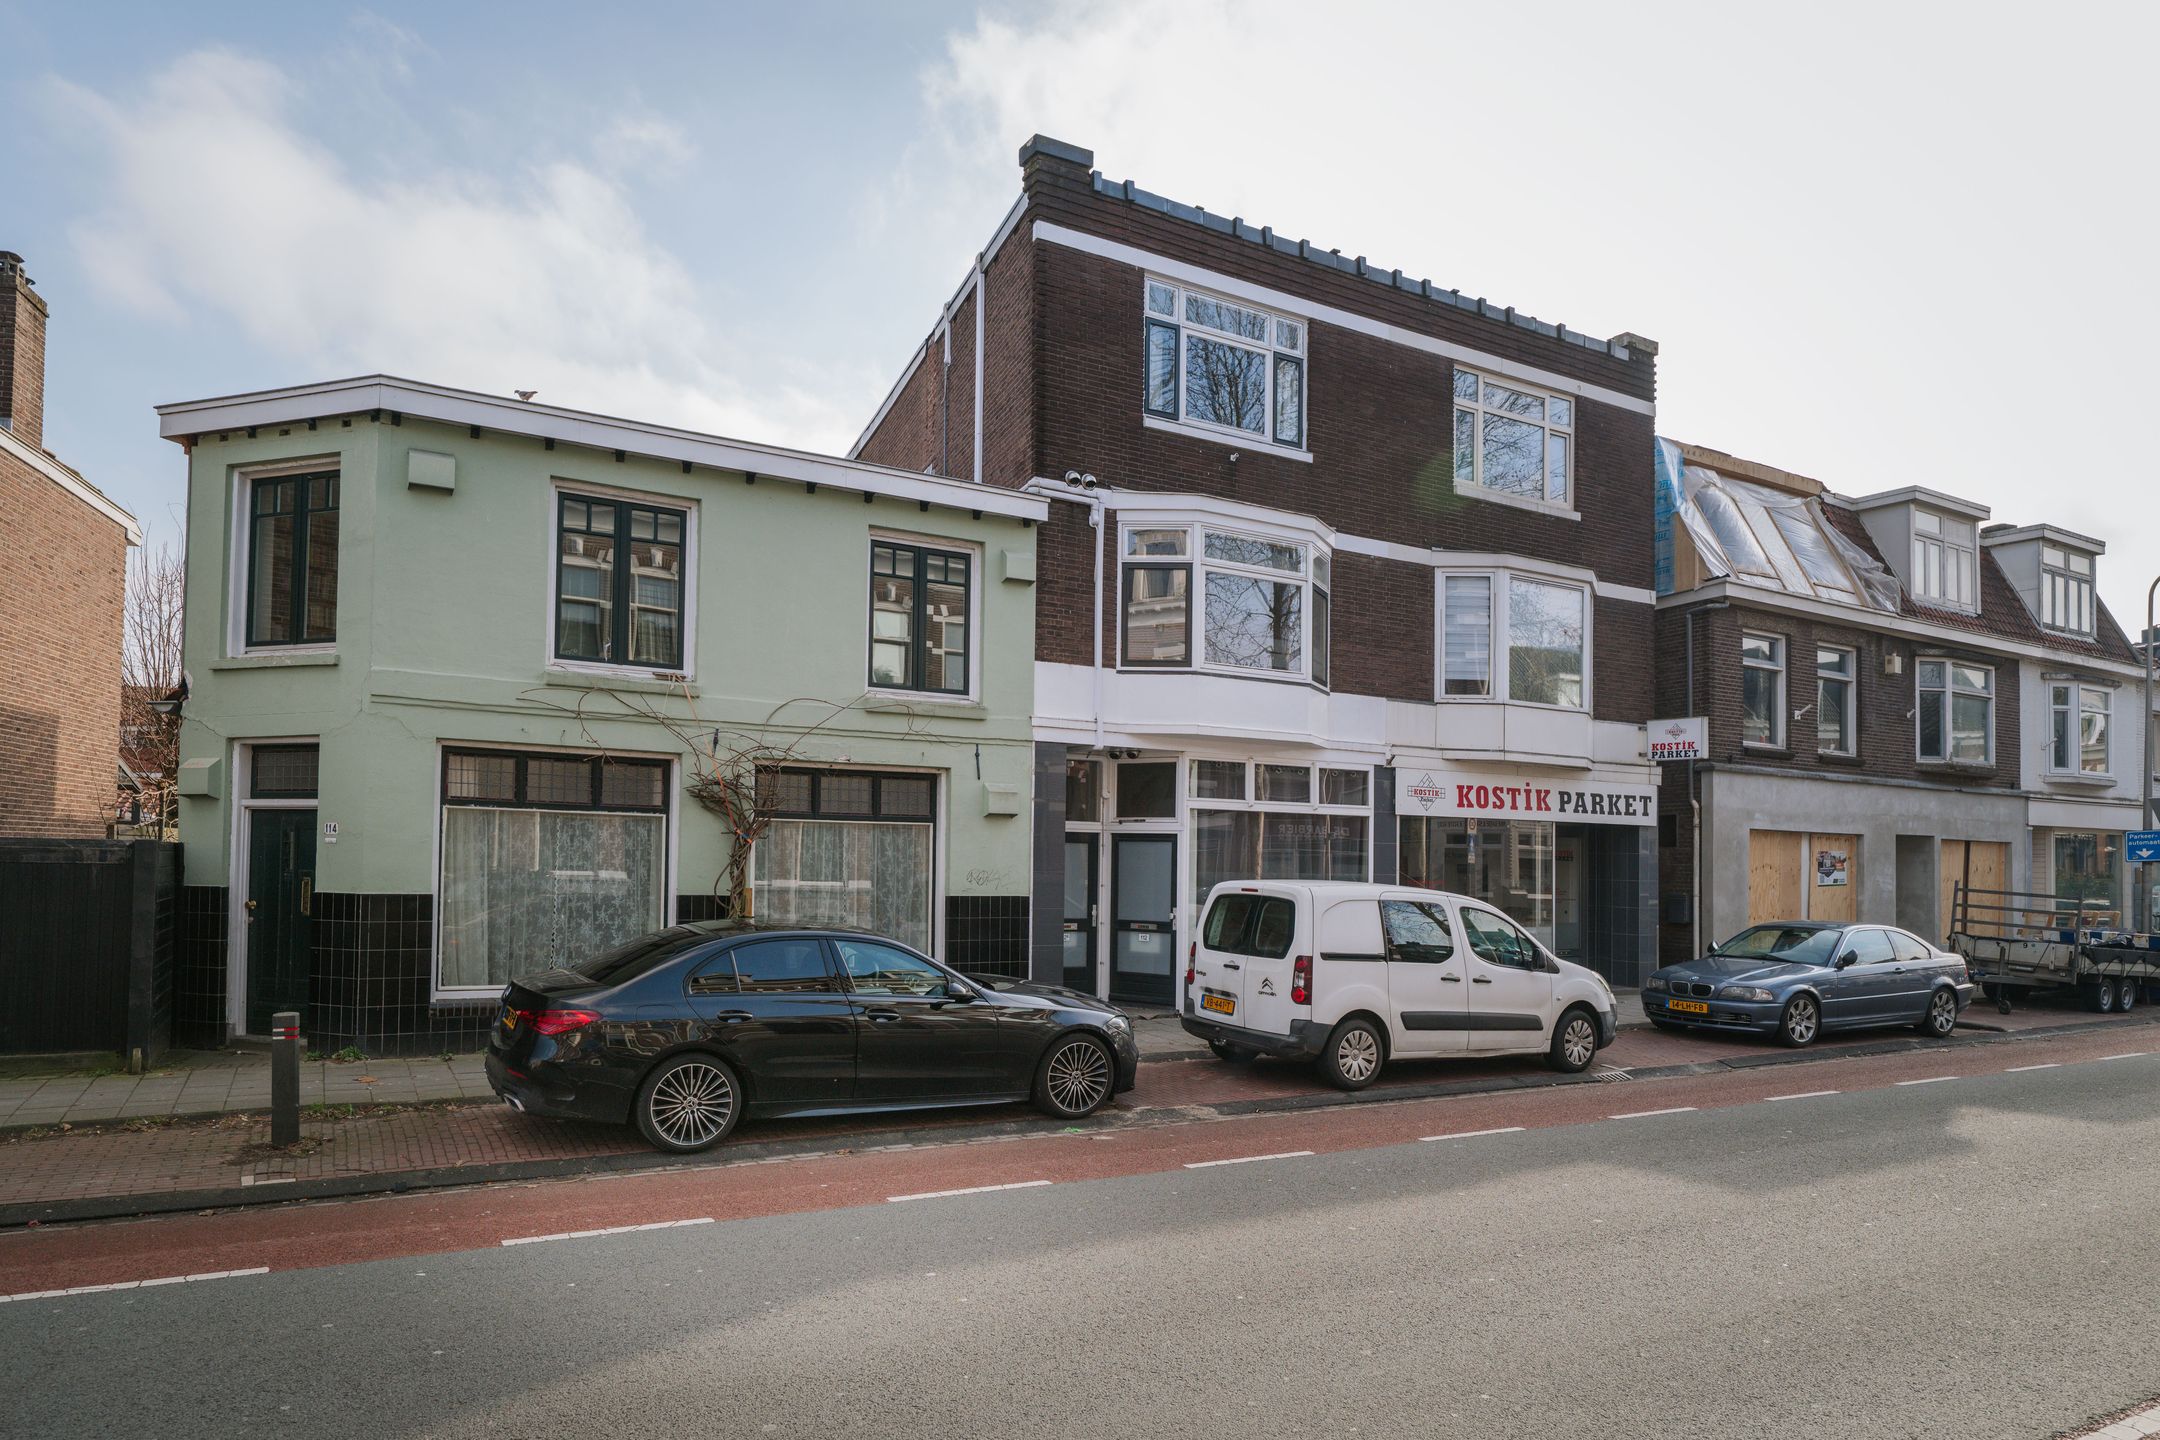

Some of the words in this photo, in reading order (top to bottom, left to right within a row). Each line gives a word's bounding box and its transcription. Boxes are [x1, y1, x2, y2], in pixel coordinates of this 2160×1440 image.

[1651, 749, 1699, 759] PARKET
[1558, 791, 1652, 816] PARKET
[325, 823, 337, 833] 114
